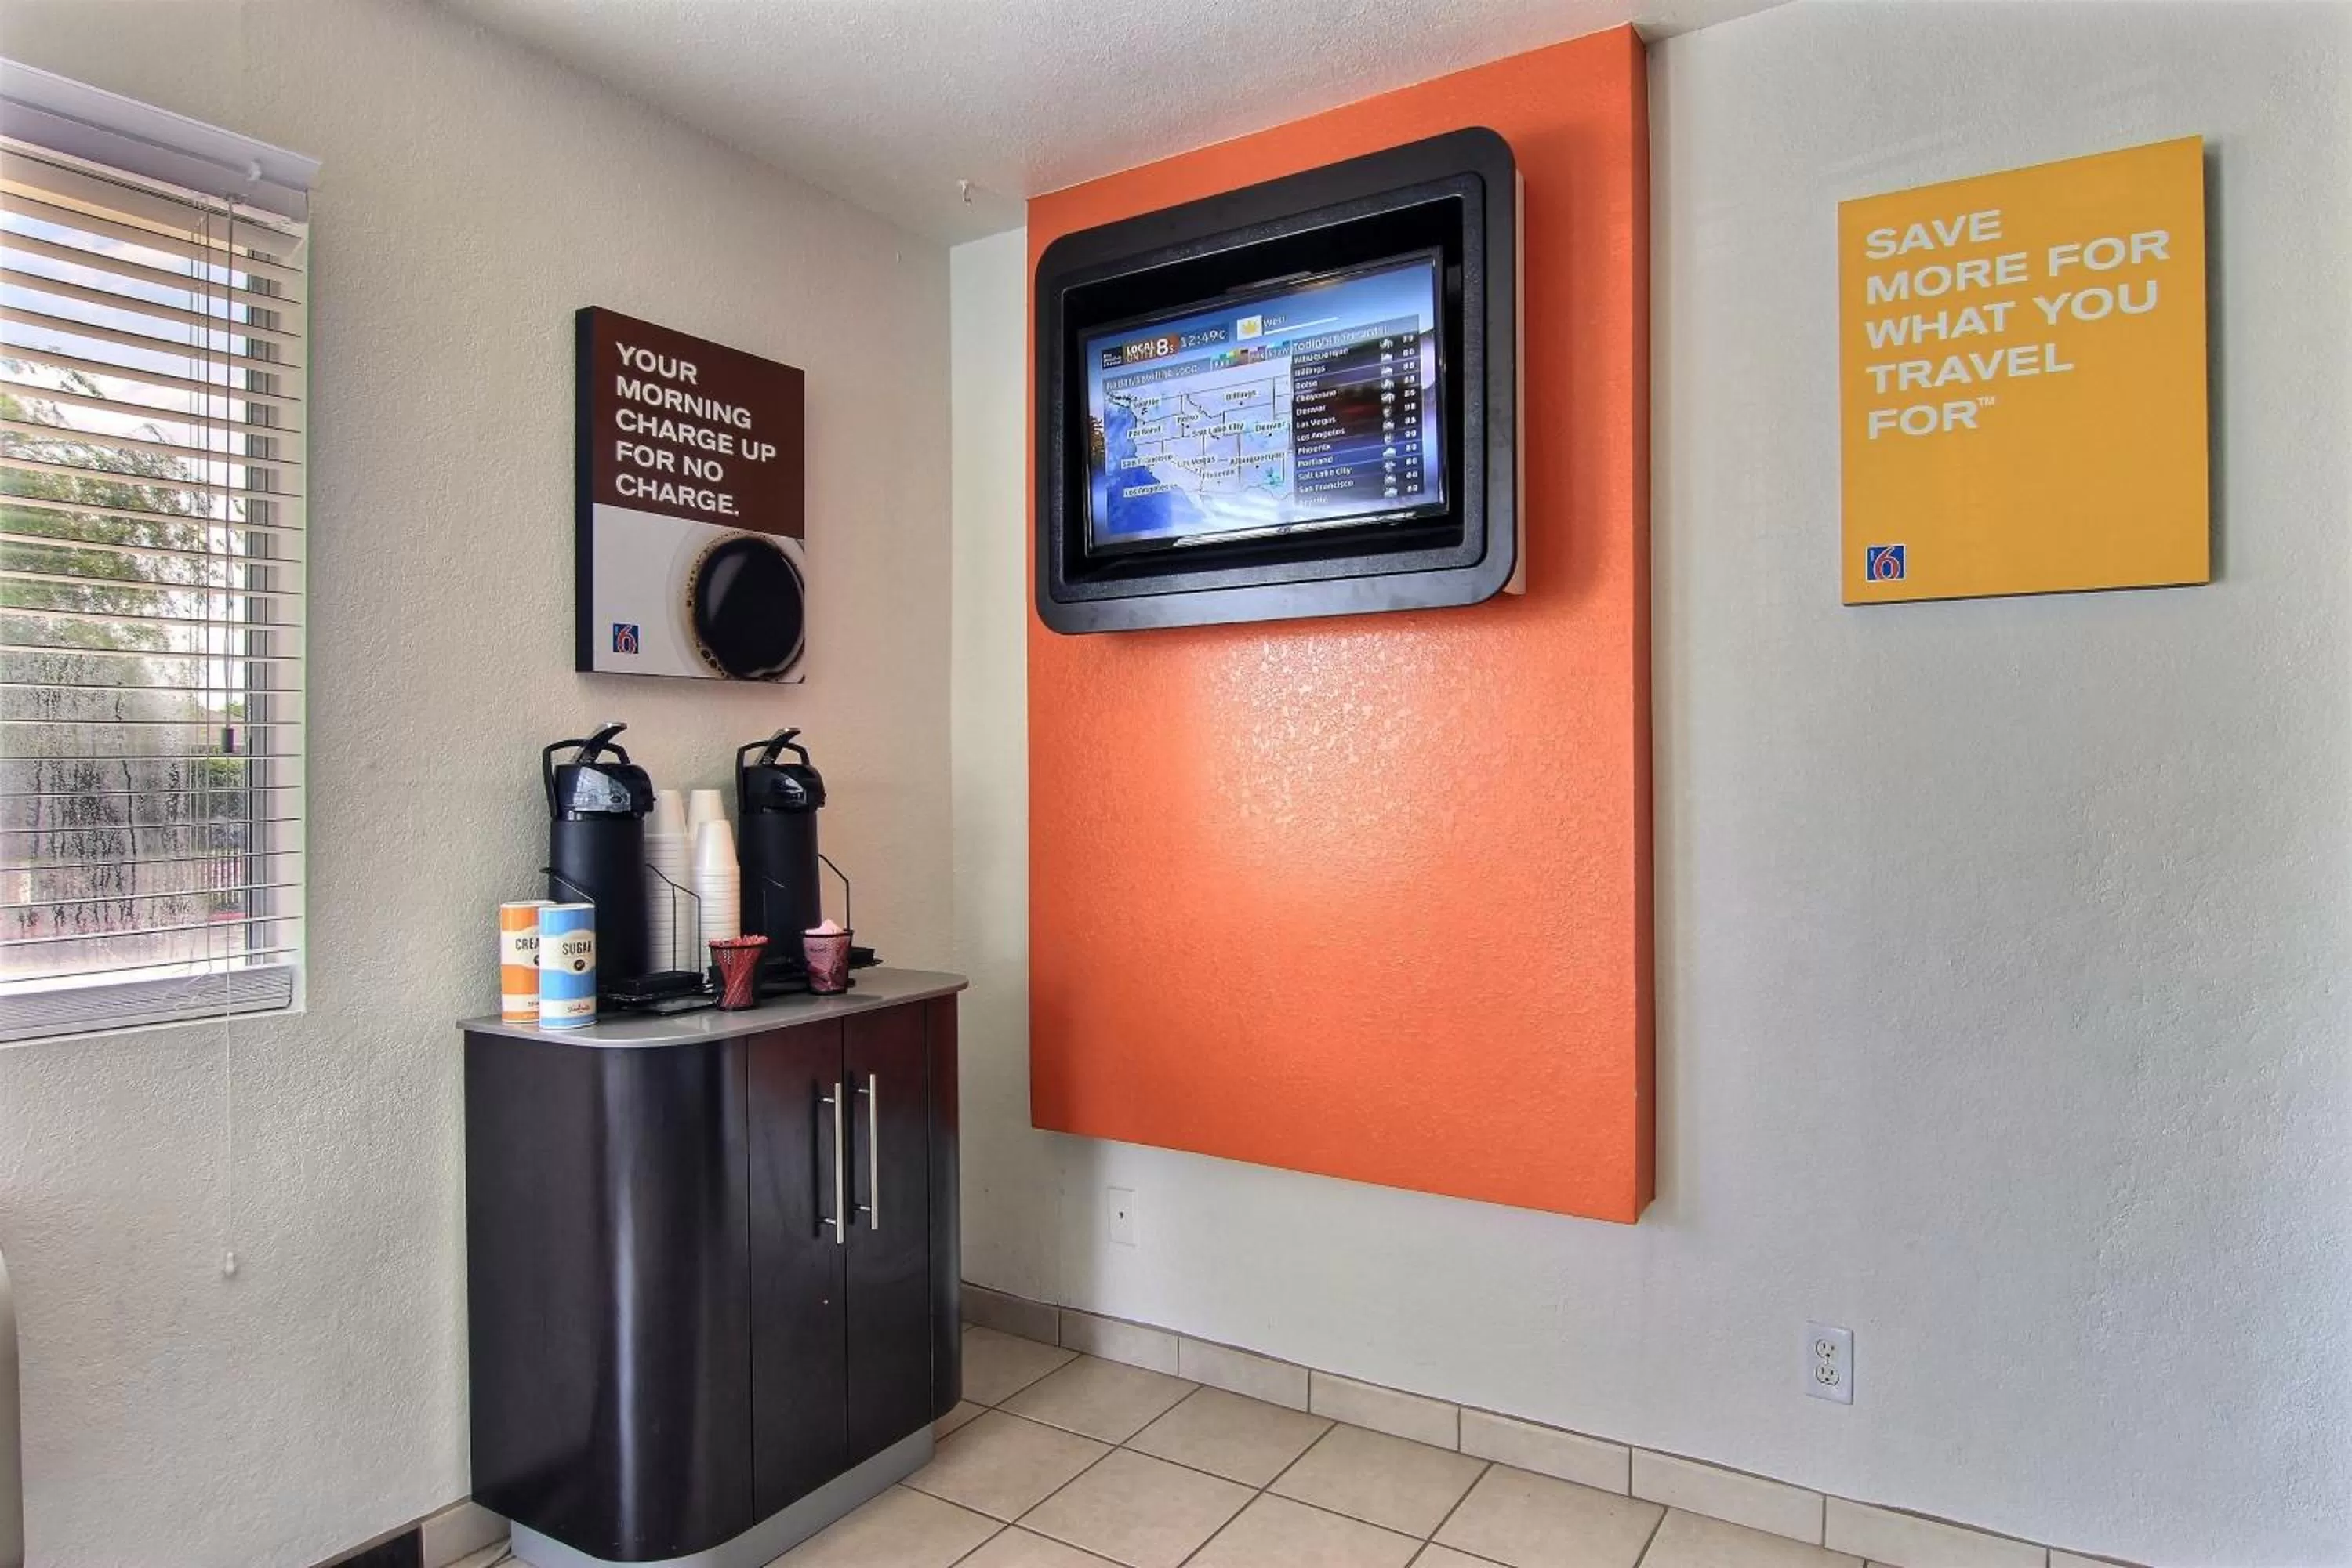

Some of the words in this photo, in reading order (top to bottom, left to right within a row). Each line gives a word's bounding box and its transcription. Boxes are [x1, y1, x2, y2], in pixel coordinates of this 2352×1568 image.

[1865, 209, 2002, 259] SAVE
[1867, 252, 2027, 305] MORE
[2049, 230, 2170, 276] FOR
[1865, 301, 2016, 350] WHAT
[2034, 280, 2157, 325] YOU
[616, 342, 698, 385] YOUR
[1127, 340, 1155, 354] LOCAL
[1866, 343, 2074, 394] TRAVEL
[616, 376, 752, 430] MORNING
[615, 408, 734, 455] CHARGE
[741, 437, 778, 463] UP
[616, 441, 675, 473] FOR
[683, 455, 724, 482] NO
[1336, 466, 1352, 477] City
[615, 472, 739, 517] CHARGE.
[562, 940, 591, 955] SUGAR
